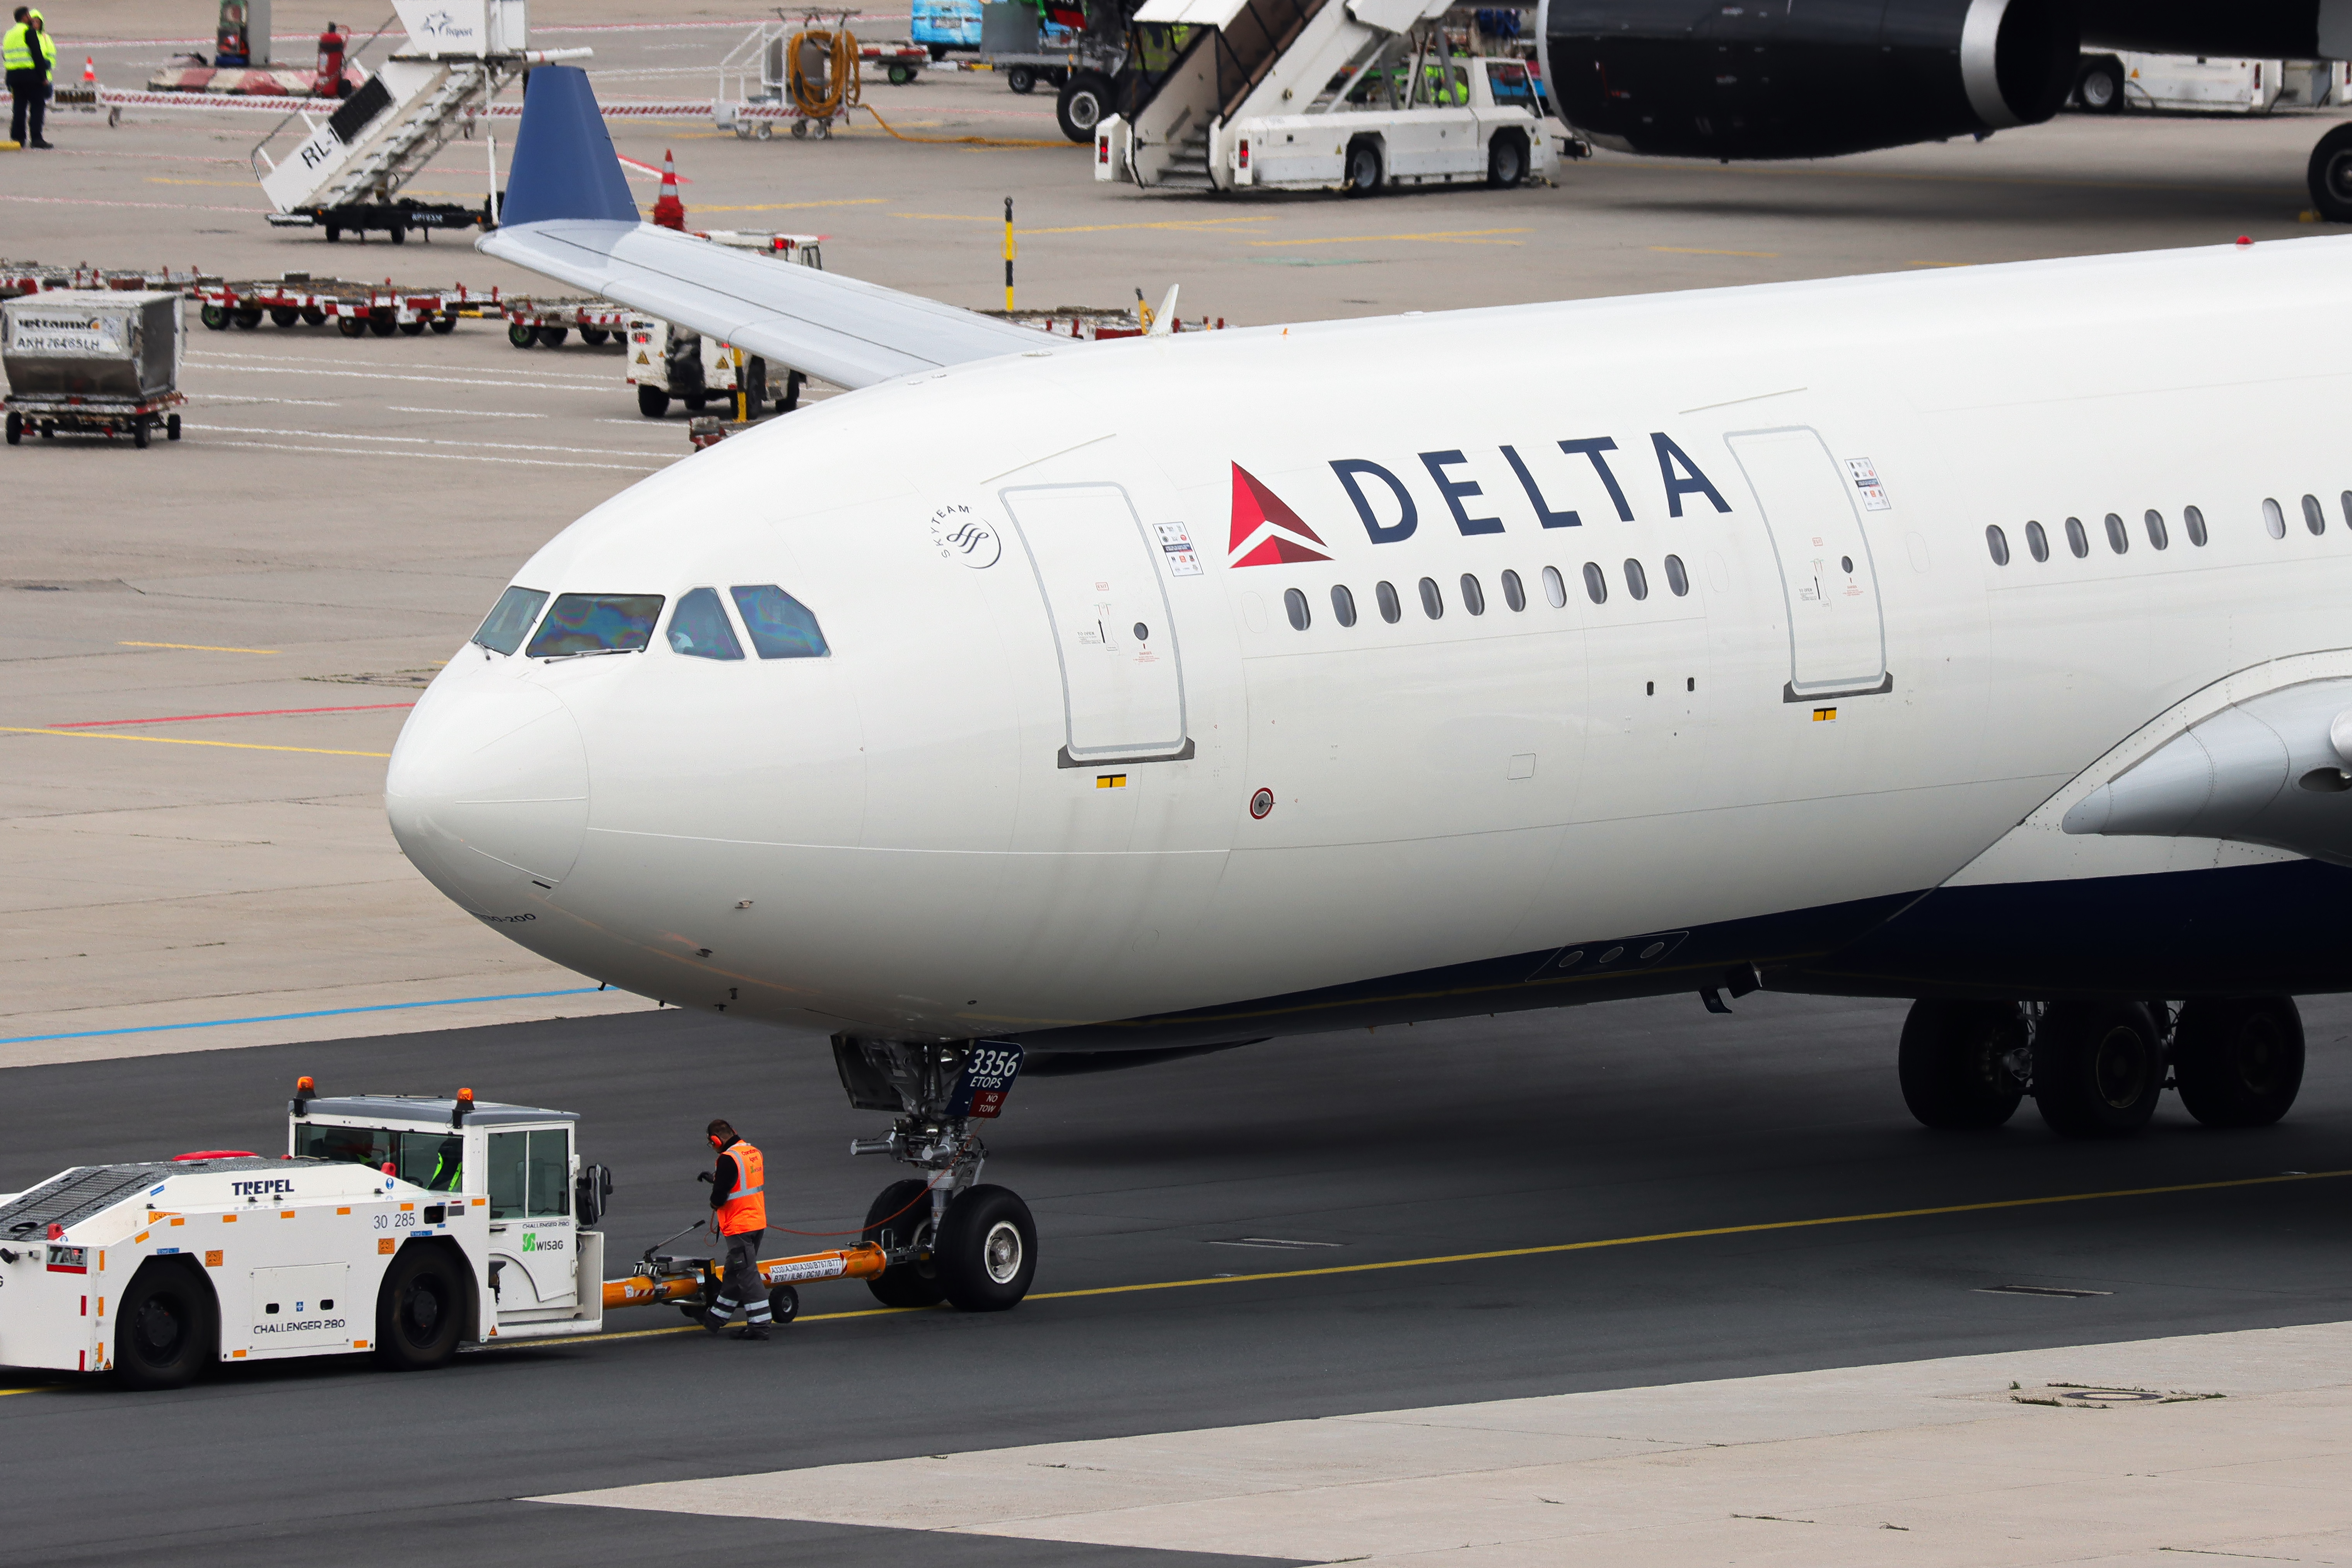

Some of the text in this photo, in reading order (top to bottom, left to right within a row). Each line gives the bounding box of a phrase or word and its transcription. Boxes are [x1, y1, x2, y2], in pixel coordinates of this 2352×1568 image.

[1328, 432, 1732, 545] DELTA
[930, 505, 970, 558] SKYTEAM
[968, 1049, 1019, 1077] 3356
[969, 1076, 1003, 1088] ETOPS
[978, 1104, 996, 1112] TOW
[232, 1179, 295, 1196] TREPEL
[374, 1213, 415, 1229] 30 285
[254, 1319, 345, 1334] CHALLENGER 280
